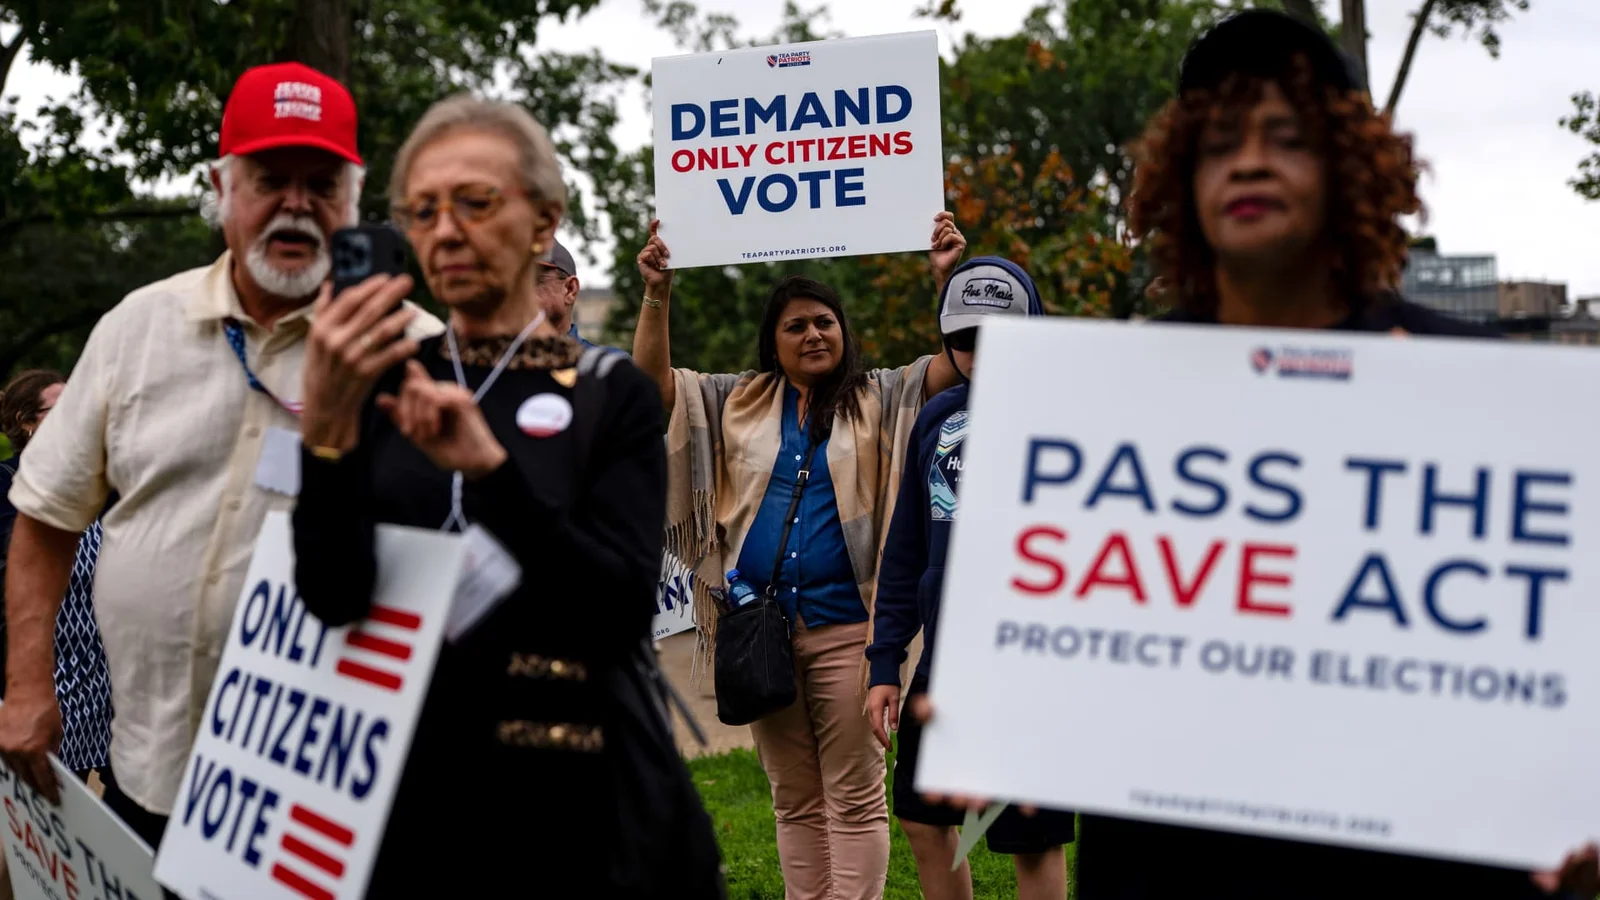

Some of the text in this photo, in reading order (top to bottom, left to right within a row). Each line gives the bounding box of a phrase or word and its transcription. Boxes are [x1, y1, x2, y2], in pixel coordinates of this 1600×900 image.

[671, 85, 912, 141] DEMAND
[671, 131, 913, 173] ONLY CITIZENS
[716, 168, 866, 215] VOTE
[742, 245, 847, 259] TEAPARTYPATRIOTS.ORG
[984, 284, 1013, 301] Maria
[1019, 434, 1575, 548] PASS THE
[1009, 523, 1571, 643] SAVE ACT
[995, 620, 1568, 709] PROTECT OUR ELECTIONS
[210, 667, 391, 802] CITIZENS
[0, 768, 71, 859] ASS
[181, 753, 282, 869] VOTE
